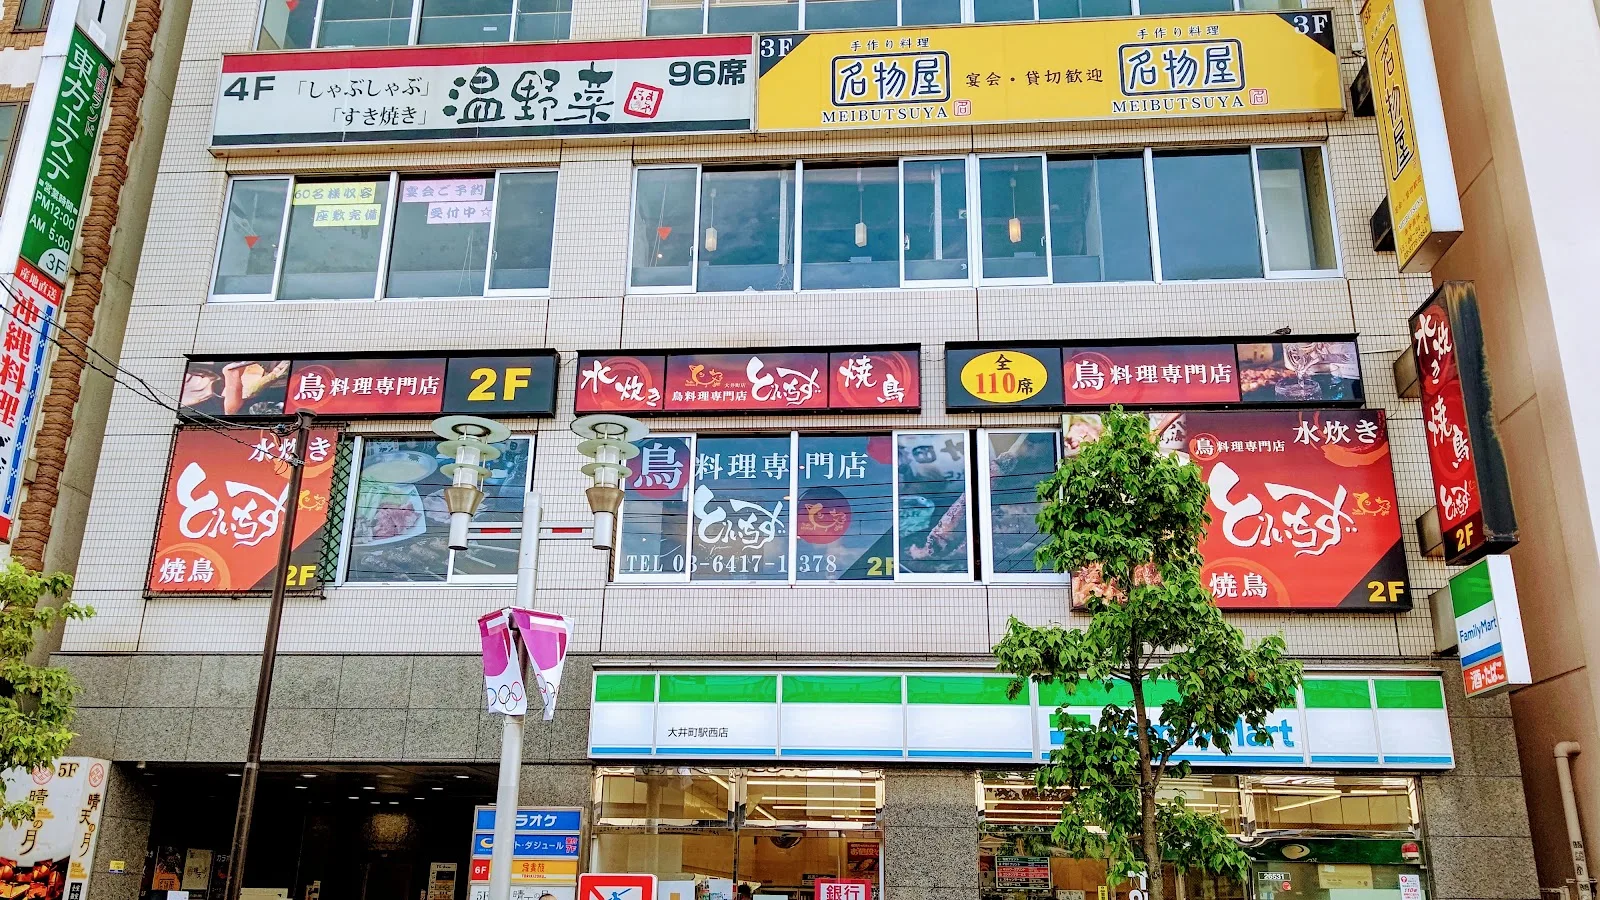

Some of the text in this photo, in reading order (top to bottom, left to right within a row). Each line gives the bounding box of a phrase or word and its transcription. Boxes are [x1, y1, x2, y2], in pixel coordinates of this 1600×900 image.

[1137, 25, 1220, 40] 手作り料理
[1293, 14, 1329, 35] 3F
[760, 37, 794, 58] 3F
[850, 37, 931, 51] 手作り料理
[668, 58, 747, 86] 96席
[838, 57, 943, 101] 名物屋
[965, 68, 1103, 87] 宴会・貸切歓迎
[1127, 45, 1236, 90] 名物屋
[223, 75, 276, 101] 4F
[298, 76, 431, 98] 「しゃぶしゃぶ」
[442, 61, 615, 124] 温野菜
[46, 42, 97, 181] 東方エステ
[332, 106, 428, 126] 「すき焼き」
[822, 106, 949, 123] MEIBUTSUYA
[1112, 95, 1245, 113] MEIBUTSUYA
[1381, 38, 1409, 172] 名物屋
[406, 184, 485, 198] 宴会ご予約
[29, 213, 71, 252] AM 5:00
[45, 252, 67, 275] 3F
[19, 265, 58, 301] 産地直送
[0, 287, 40, 429] 沖縄料理
[994, 353, 1013, 371] 全
[1414, 313, 1453, 385] 水炊き
[294, 372, 441, 402] 鳥料理専門店
[467, 367, 533, 401] 2F
[581, 360, 661, 407] 水炊き
[838, 354, 906, 404] 焼鳥
[975, 371, 1033, 395] 110席
[1071, 359, 1233, 392] 鳥料理専門店
[671, 390, 748, 402] 鳥料理専門店
[1292, 419, 1379, 446] 水炊き
[1427, 395, 1470, 469] 焼鳥
[1194, 437, 1286, 456] 鳥料理専門店
[633, 441, 869, 490] 鳥料理専門店
[1455, 522, 1474, 553] 2F
[158, 557, 215, 584] 焼鳥
[285, 565, 317, 586] 2F
[626, 554, 663, 573] TEL
[1209, 572, 1268, 599] 焼鳥
[1367, 580, 1405, 603] 2F
[1459, 616, 1498, 644] FamilyMart
[1470, 660, 1505, 691] 酒・たばこ
[667, 726, 729, 739] 大井町駅西店
[58, 762, 80, 778] 5F
[19, 788, 49, 856] 晴の月
[79, 793, 101, 858] 晴天の月
[514, 813, 557, 827] ラオケ
[513, 840, 564, 851] ト・ダジュール
[474, 866, 488, 874] 6F
[826, 885, 860, 900] 銀行
